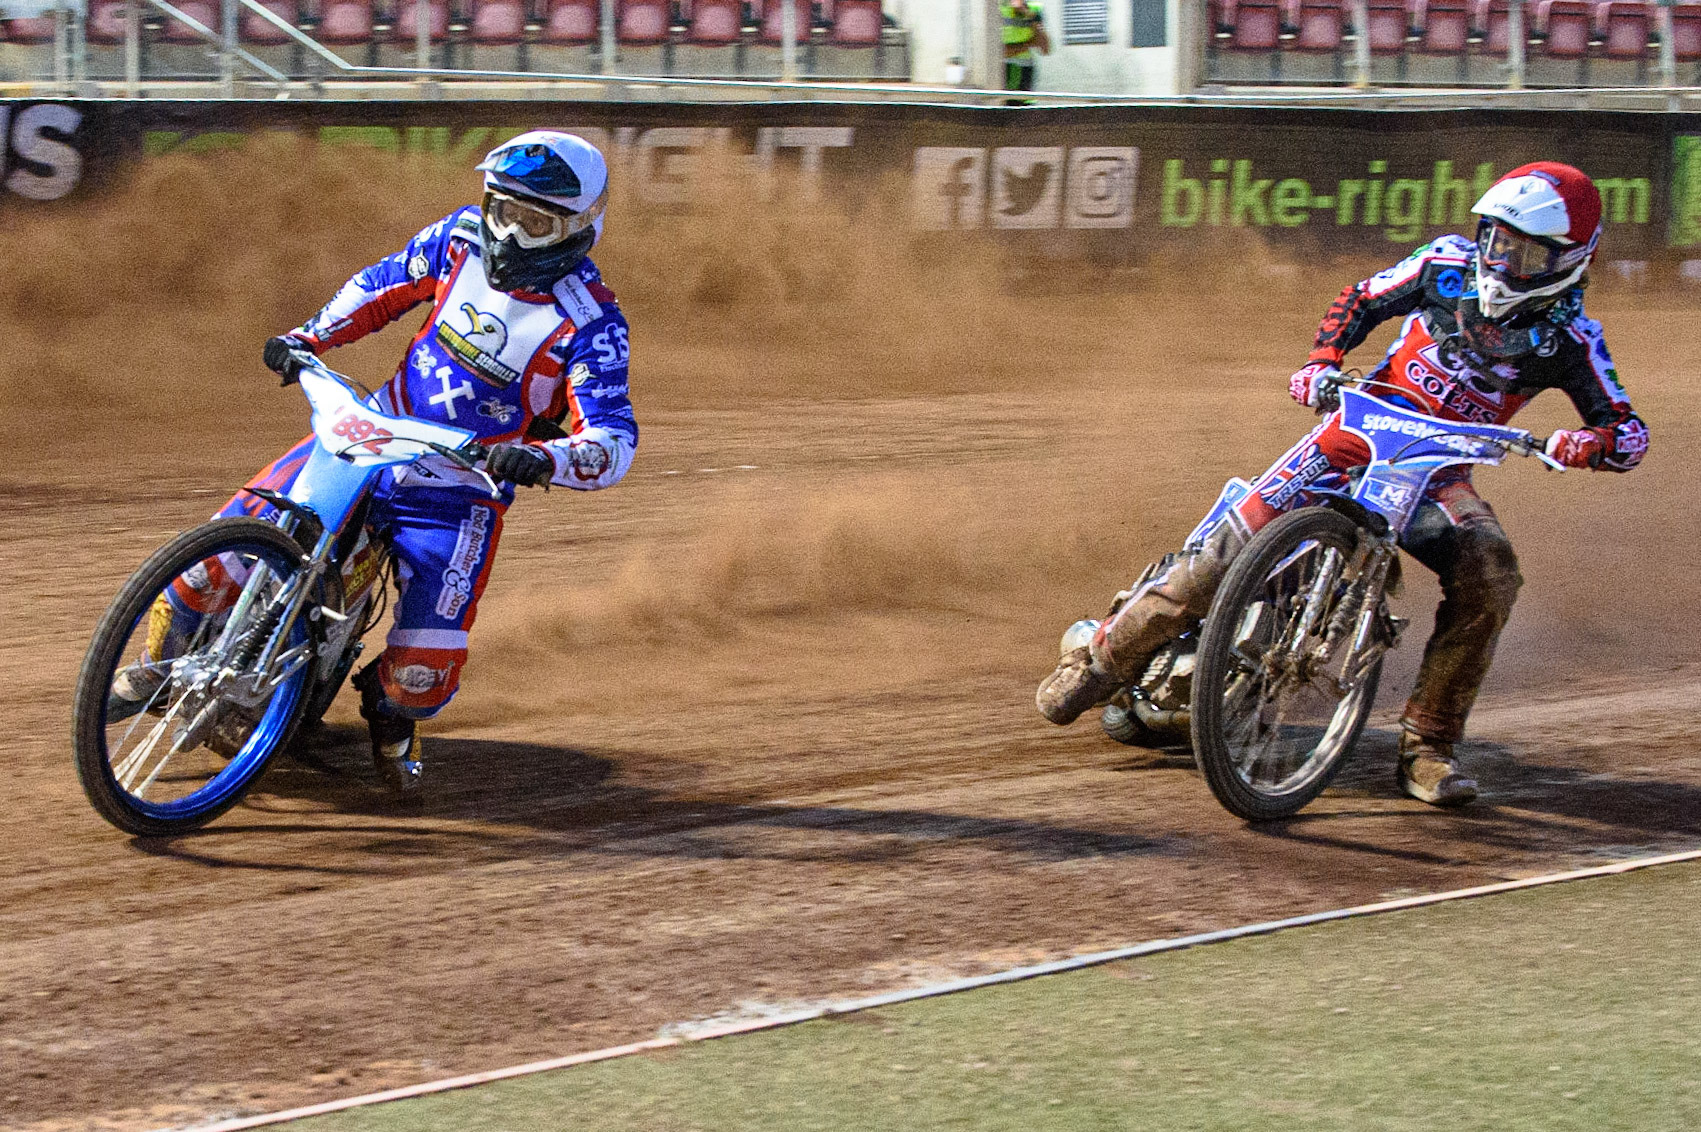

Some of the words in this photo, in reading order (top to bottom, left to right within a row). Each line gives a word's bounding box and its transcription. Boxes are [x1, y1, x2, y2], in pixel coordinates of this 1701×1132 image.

[1405, 361, 1498, 424] COLTS
[461, 531, 483, 574] Butcher
[445, 569, 469, 592] &
[447, 592, 467, 617] Son
